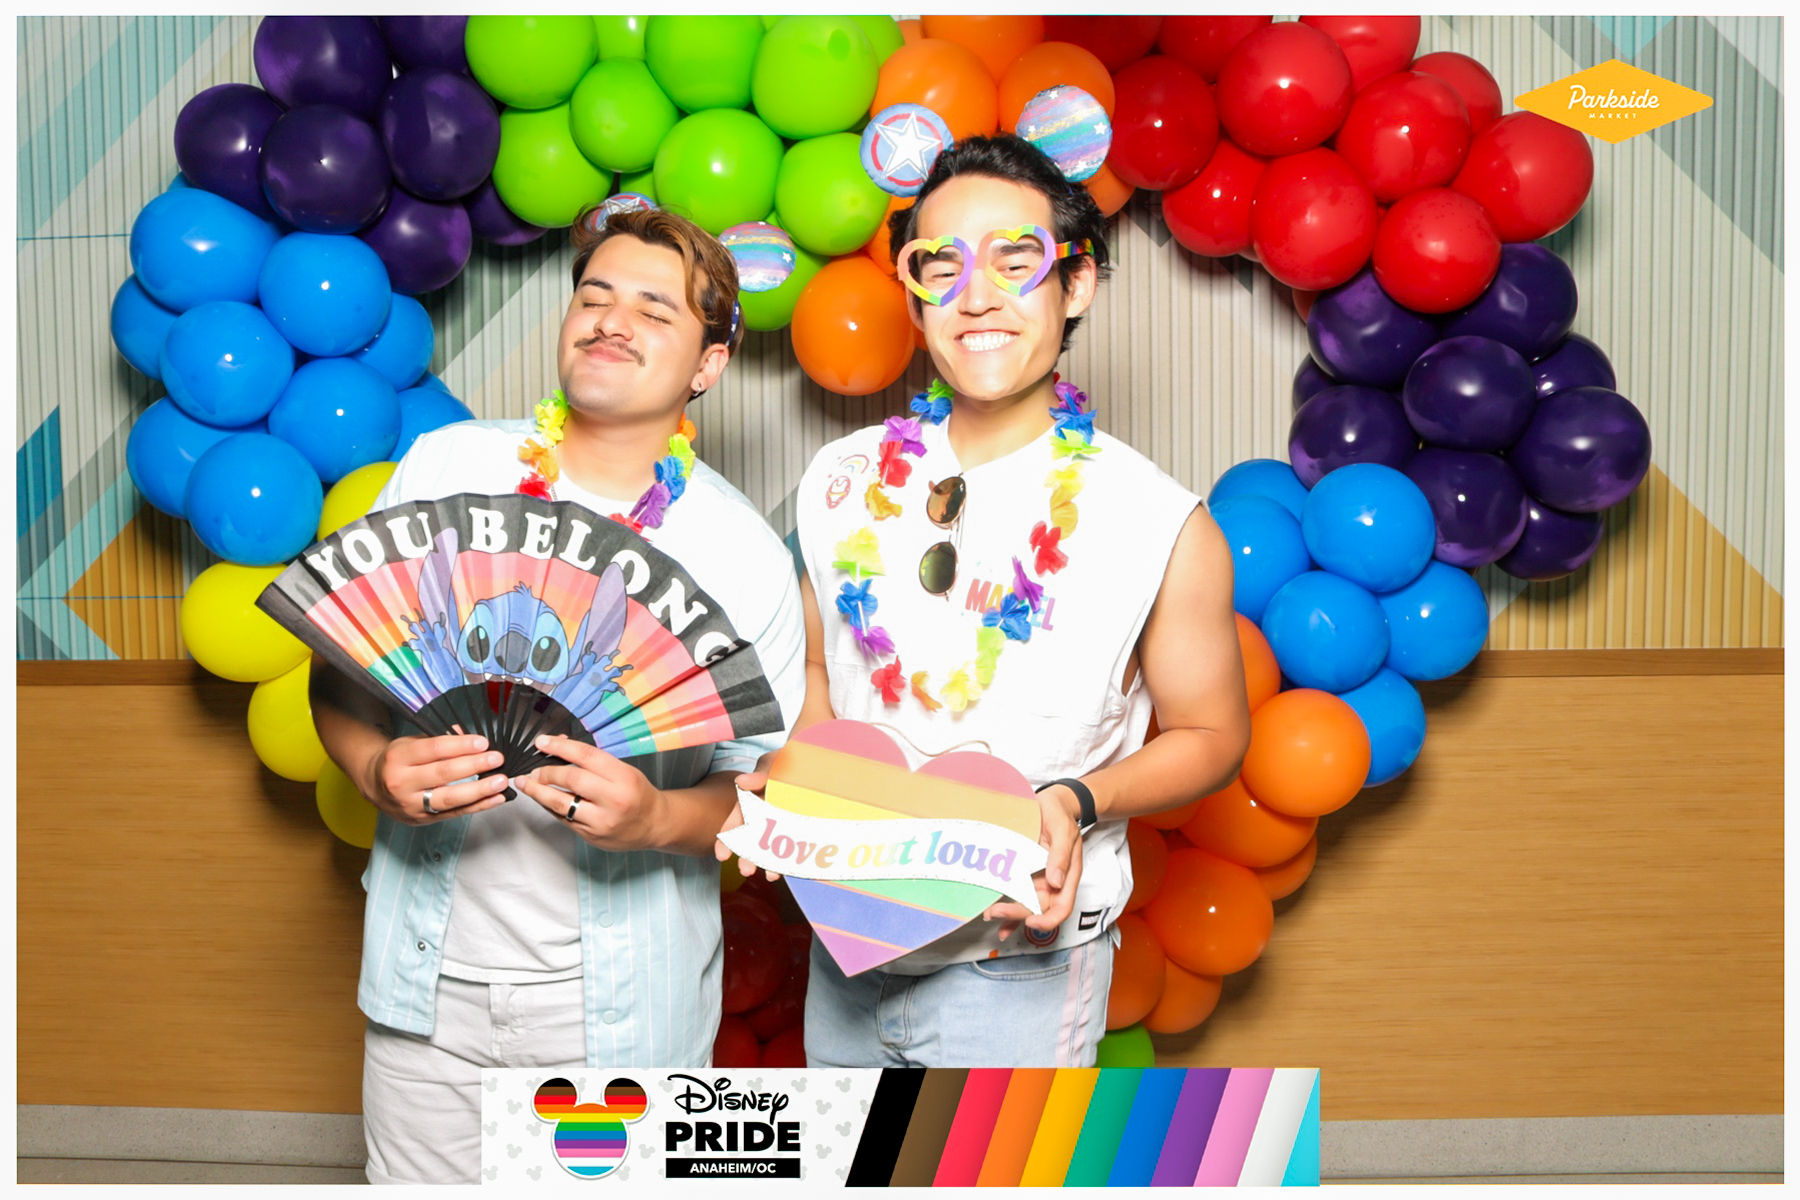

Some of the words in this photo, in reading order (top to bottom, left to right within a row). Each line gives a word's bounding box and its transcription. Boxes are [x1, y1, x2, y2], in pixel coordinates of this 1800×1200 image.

[306, 511, 432, 591] YOU
[965, 578, 1056, 631] MAEL
[757, 819, 839, 868] love
[847, 837, 918, 869] out
[924, 831, 1017, 882] loud
